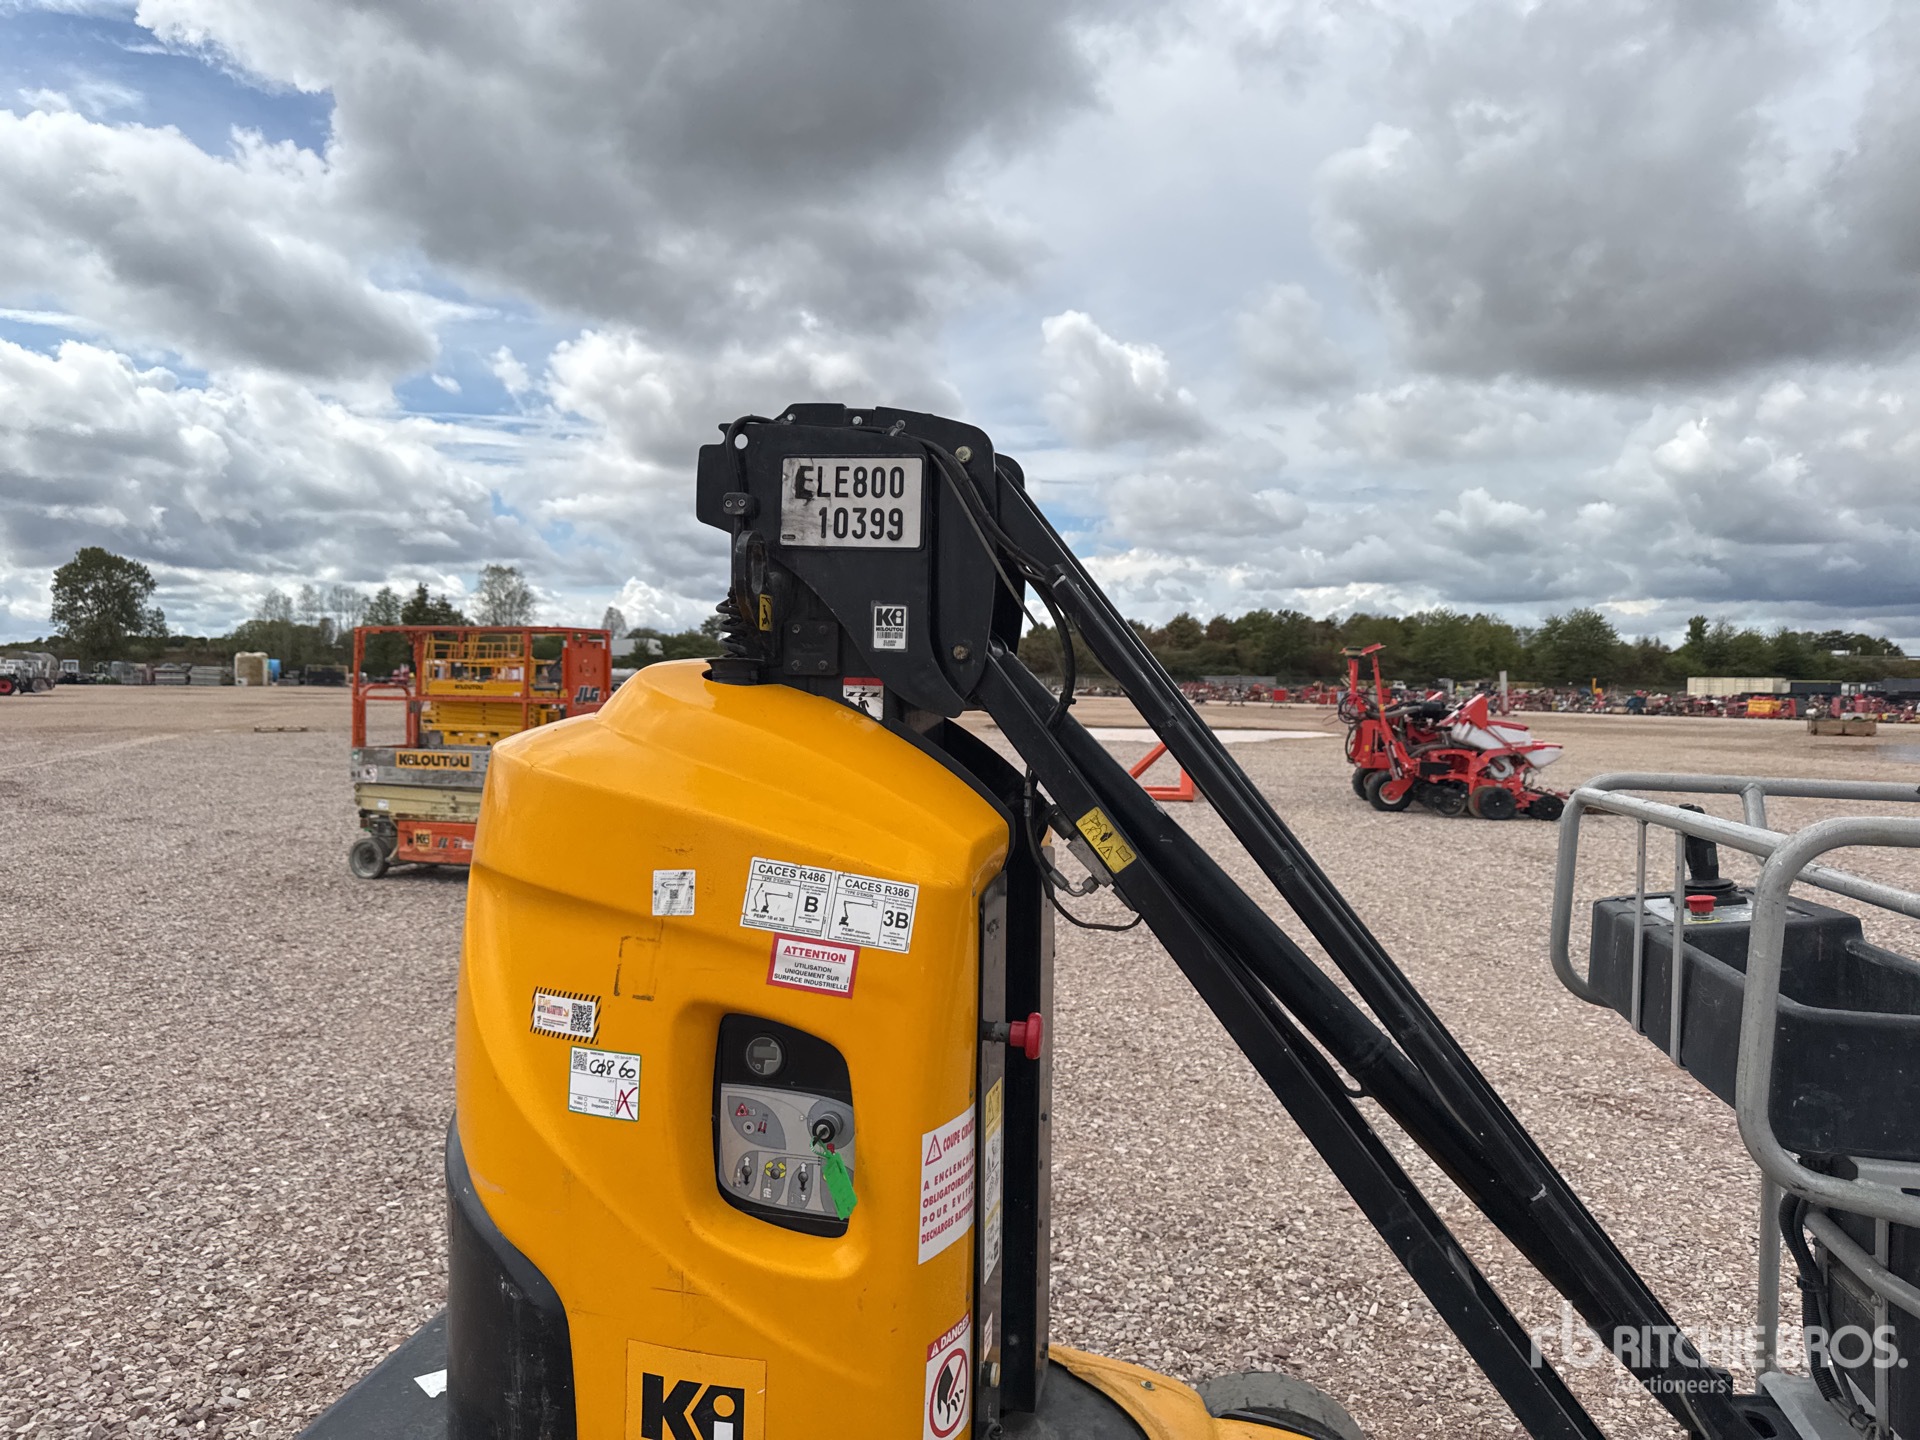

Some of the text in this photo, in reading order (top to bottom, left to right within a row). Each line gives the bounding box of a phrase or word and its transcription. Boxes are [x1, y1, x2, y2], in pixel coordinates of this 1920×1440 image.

[795, 466, 905, 499] ELE800
[818, 507, 904, 541] 10399
[575, 686, 600, 702] JLG
[758, 864, 826, 883] CACES R486
[845, 879, 910, 898] CACES R386
[804, 896, 819, 913] B
[883, 910, 909, 929] 3B
[783, 945, 847, 963] ATTENTION
[784, 968, 839, 982] UNIQUEMENT SUR
[794, 962, 832, 973] UTILISATION
[774, 973, 848, 991] SURFACE INDUSTRIELLE
[943, 1129, 960, 1152] COUPE
[923, 1148, 974, 1191] A ENCLENCHER
[922, 1165, 974, 1208] OBLIGATOIREMENT
[922, 1182, 974, 1227] POUR EVITER
[921, 1215, 954, 1244] DECHARGES
[940, 1313, 969, 1347] DANGER
